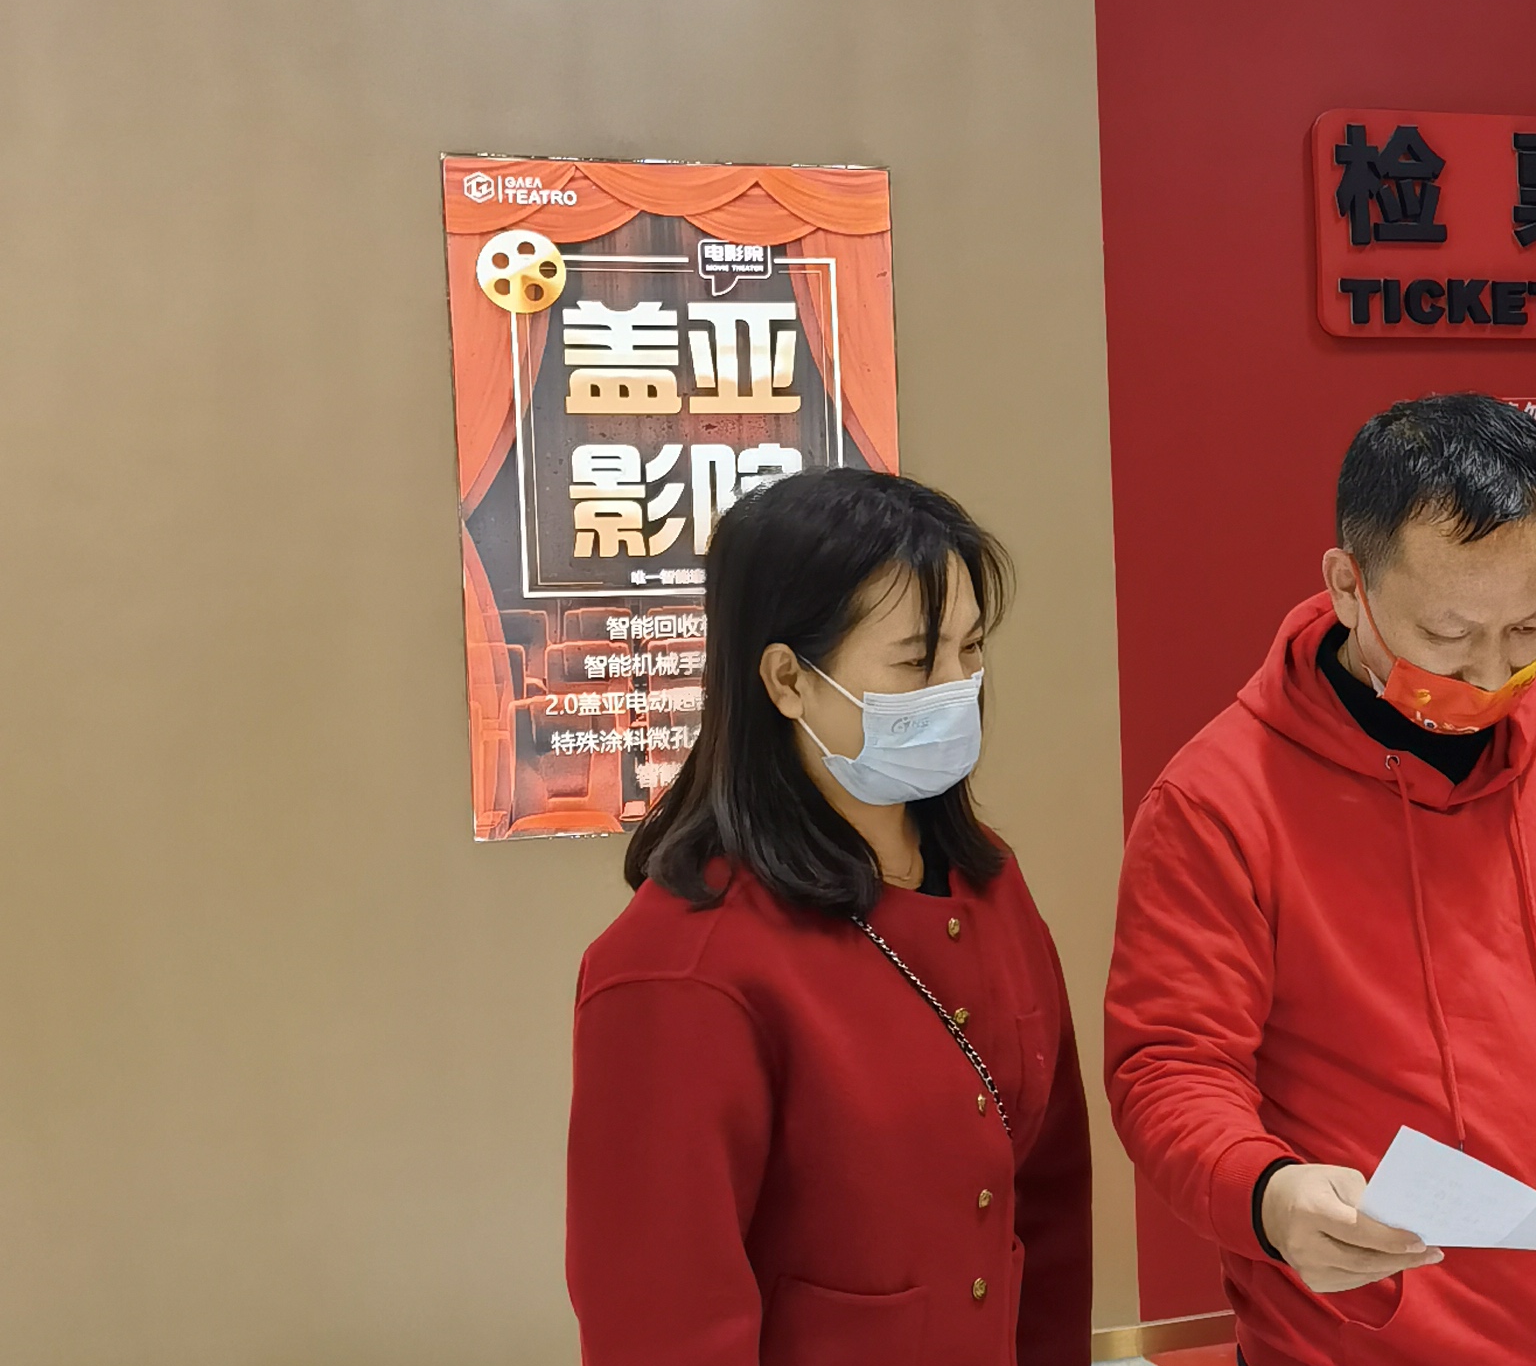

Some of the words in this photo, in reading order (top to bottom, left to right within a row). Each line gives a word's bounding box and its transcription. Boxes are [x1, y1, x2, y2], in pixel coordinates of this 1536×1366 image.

[504, 189, 577, 206] TEATRO
[703, 244, 764, 262] 电影院
[561, 300, 802, 415] 盖亚
[605, 613, 708, 641] 智能回收
[583, 652, 707, 679] 智能机械手
